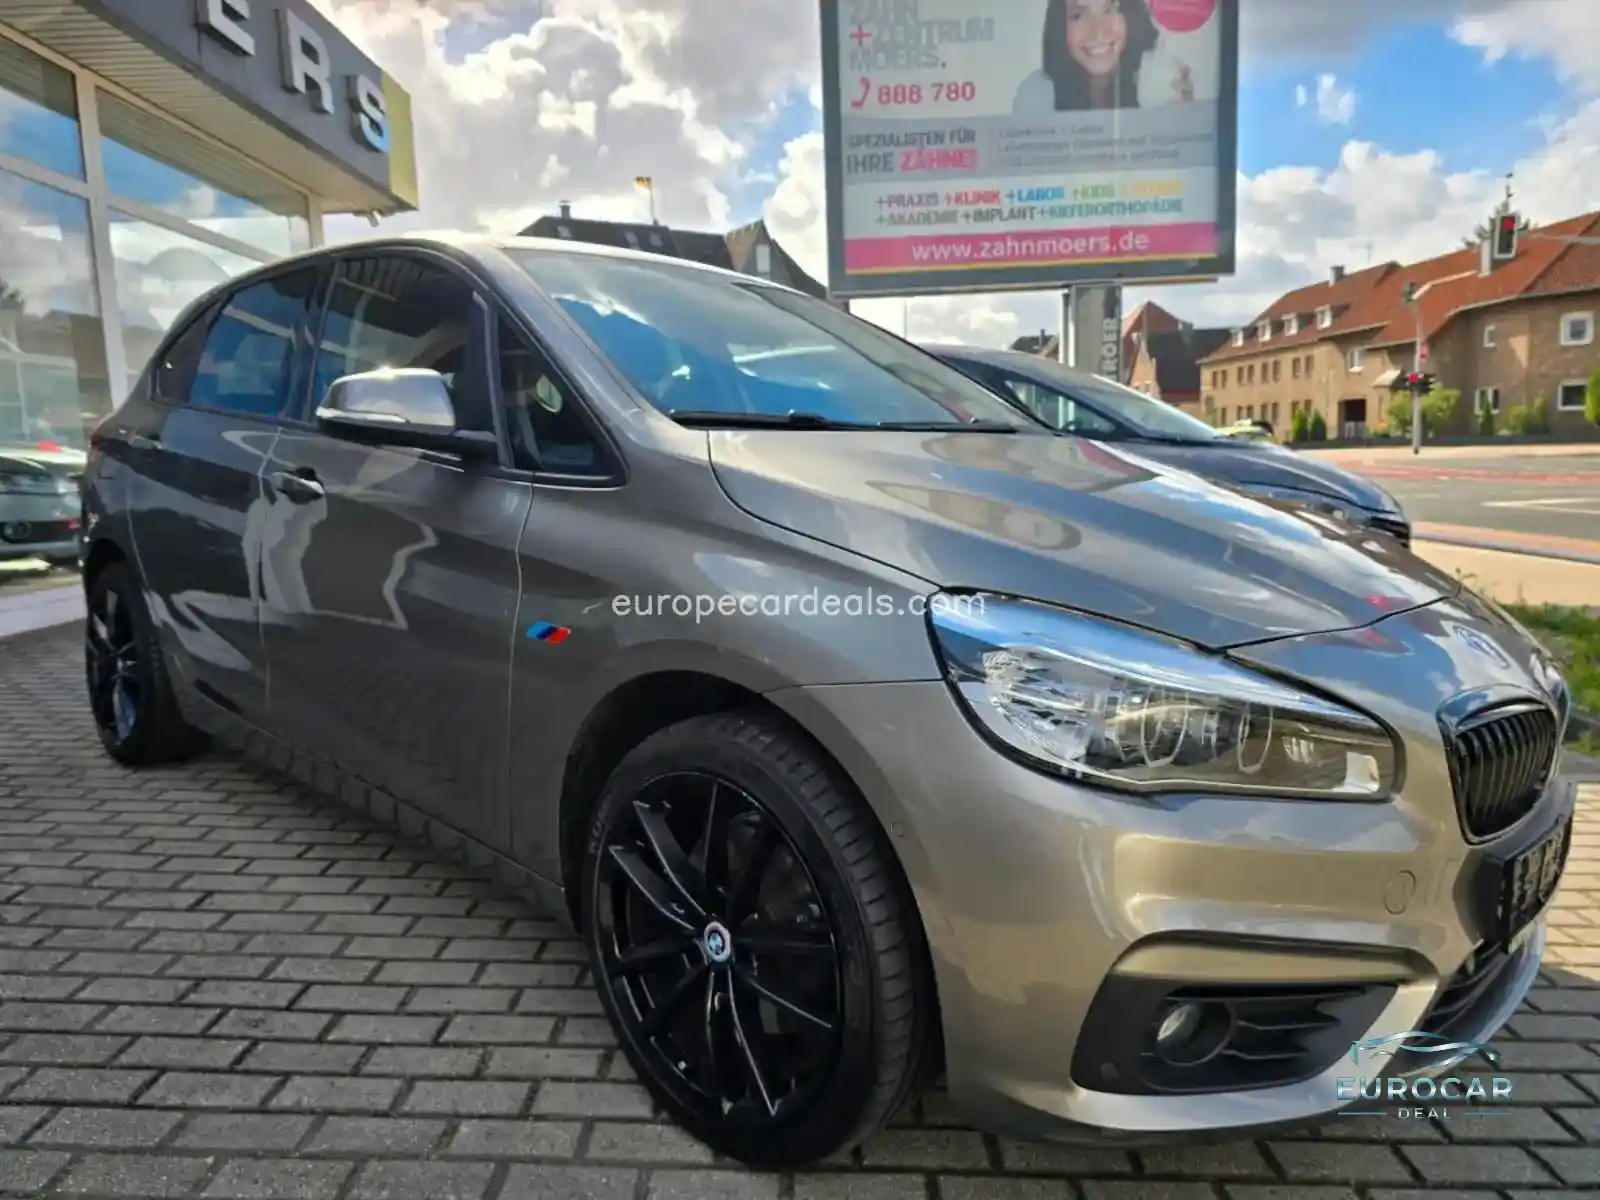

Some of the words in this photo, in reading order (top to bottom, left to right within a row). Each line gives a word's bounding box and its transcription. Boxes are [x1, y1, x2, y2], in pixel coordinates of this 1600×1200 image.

[931, 81, 976, 102] 780
[848, 130, 945, 149] SPEZIALISTEN
[951, 127, 976, 144] FÜR
[847, 152, 894, 174] IHRE
[911, 231, 1149, 261] www.zahnmoers.de
